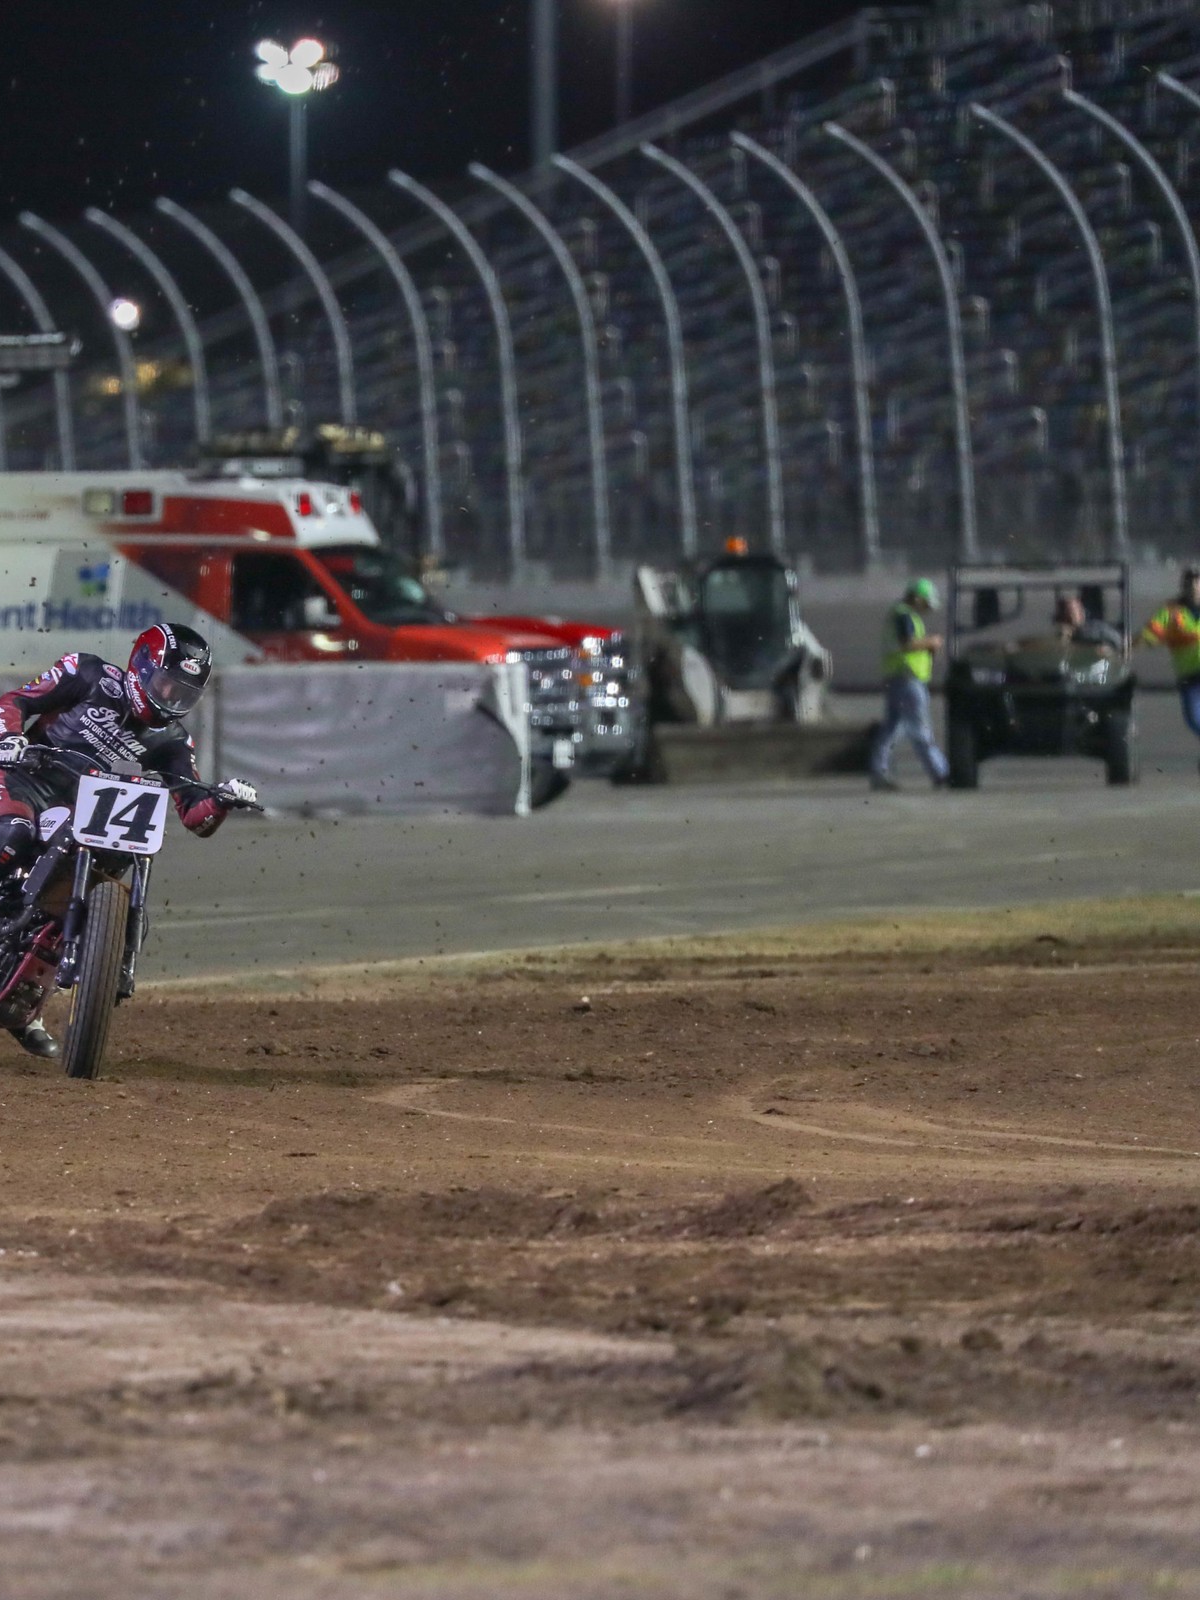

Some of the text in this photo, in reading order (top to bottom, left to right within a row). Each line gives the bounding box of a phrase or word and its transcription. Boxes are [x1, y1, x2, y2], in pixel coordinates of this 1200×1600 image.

[106, 667, 122, 679] BELL
[183, 663, 199, 672] BELL
[79, 714, 120, 749] MOTORCYCLE
[117, 744, 138, 763] RACING
[86, 706, 148, 756] Indian
[79, 787, 161, 844] 14
